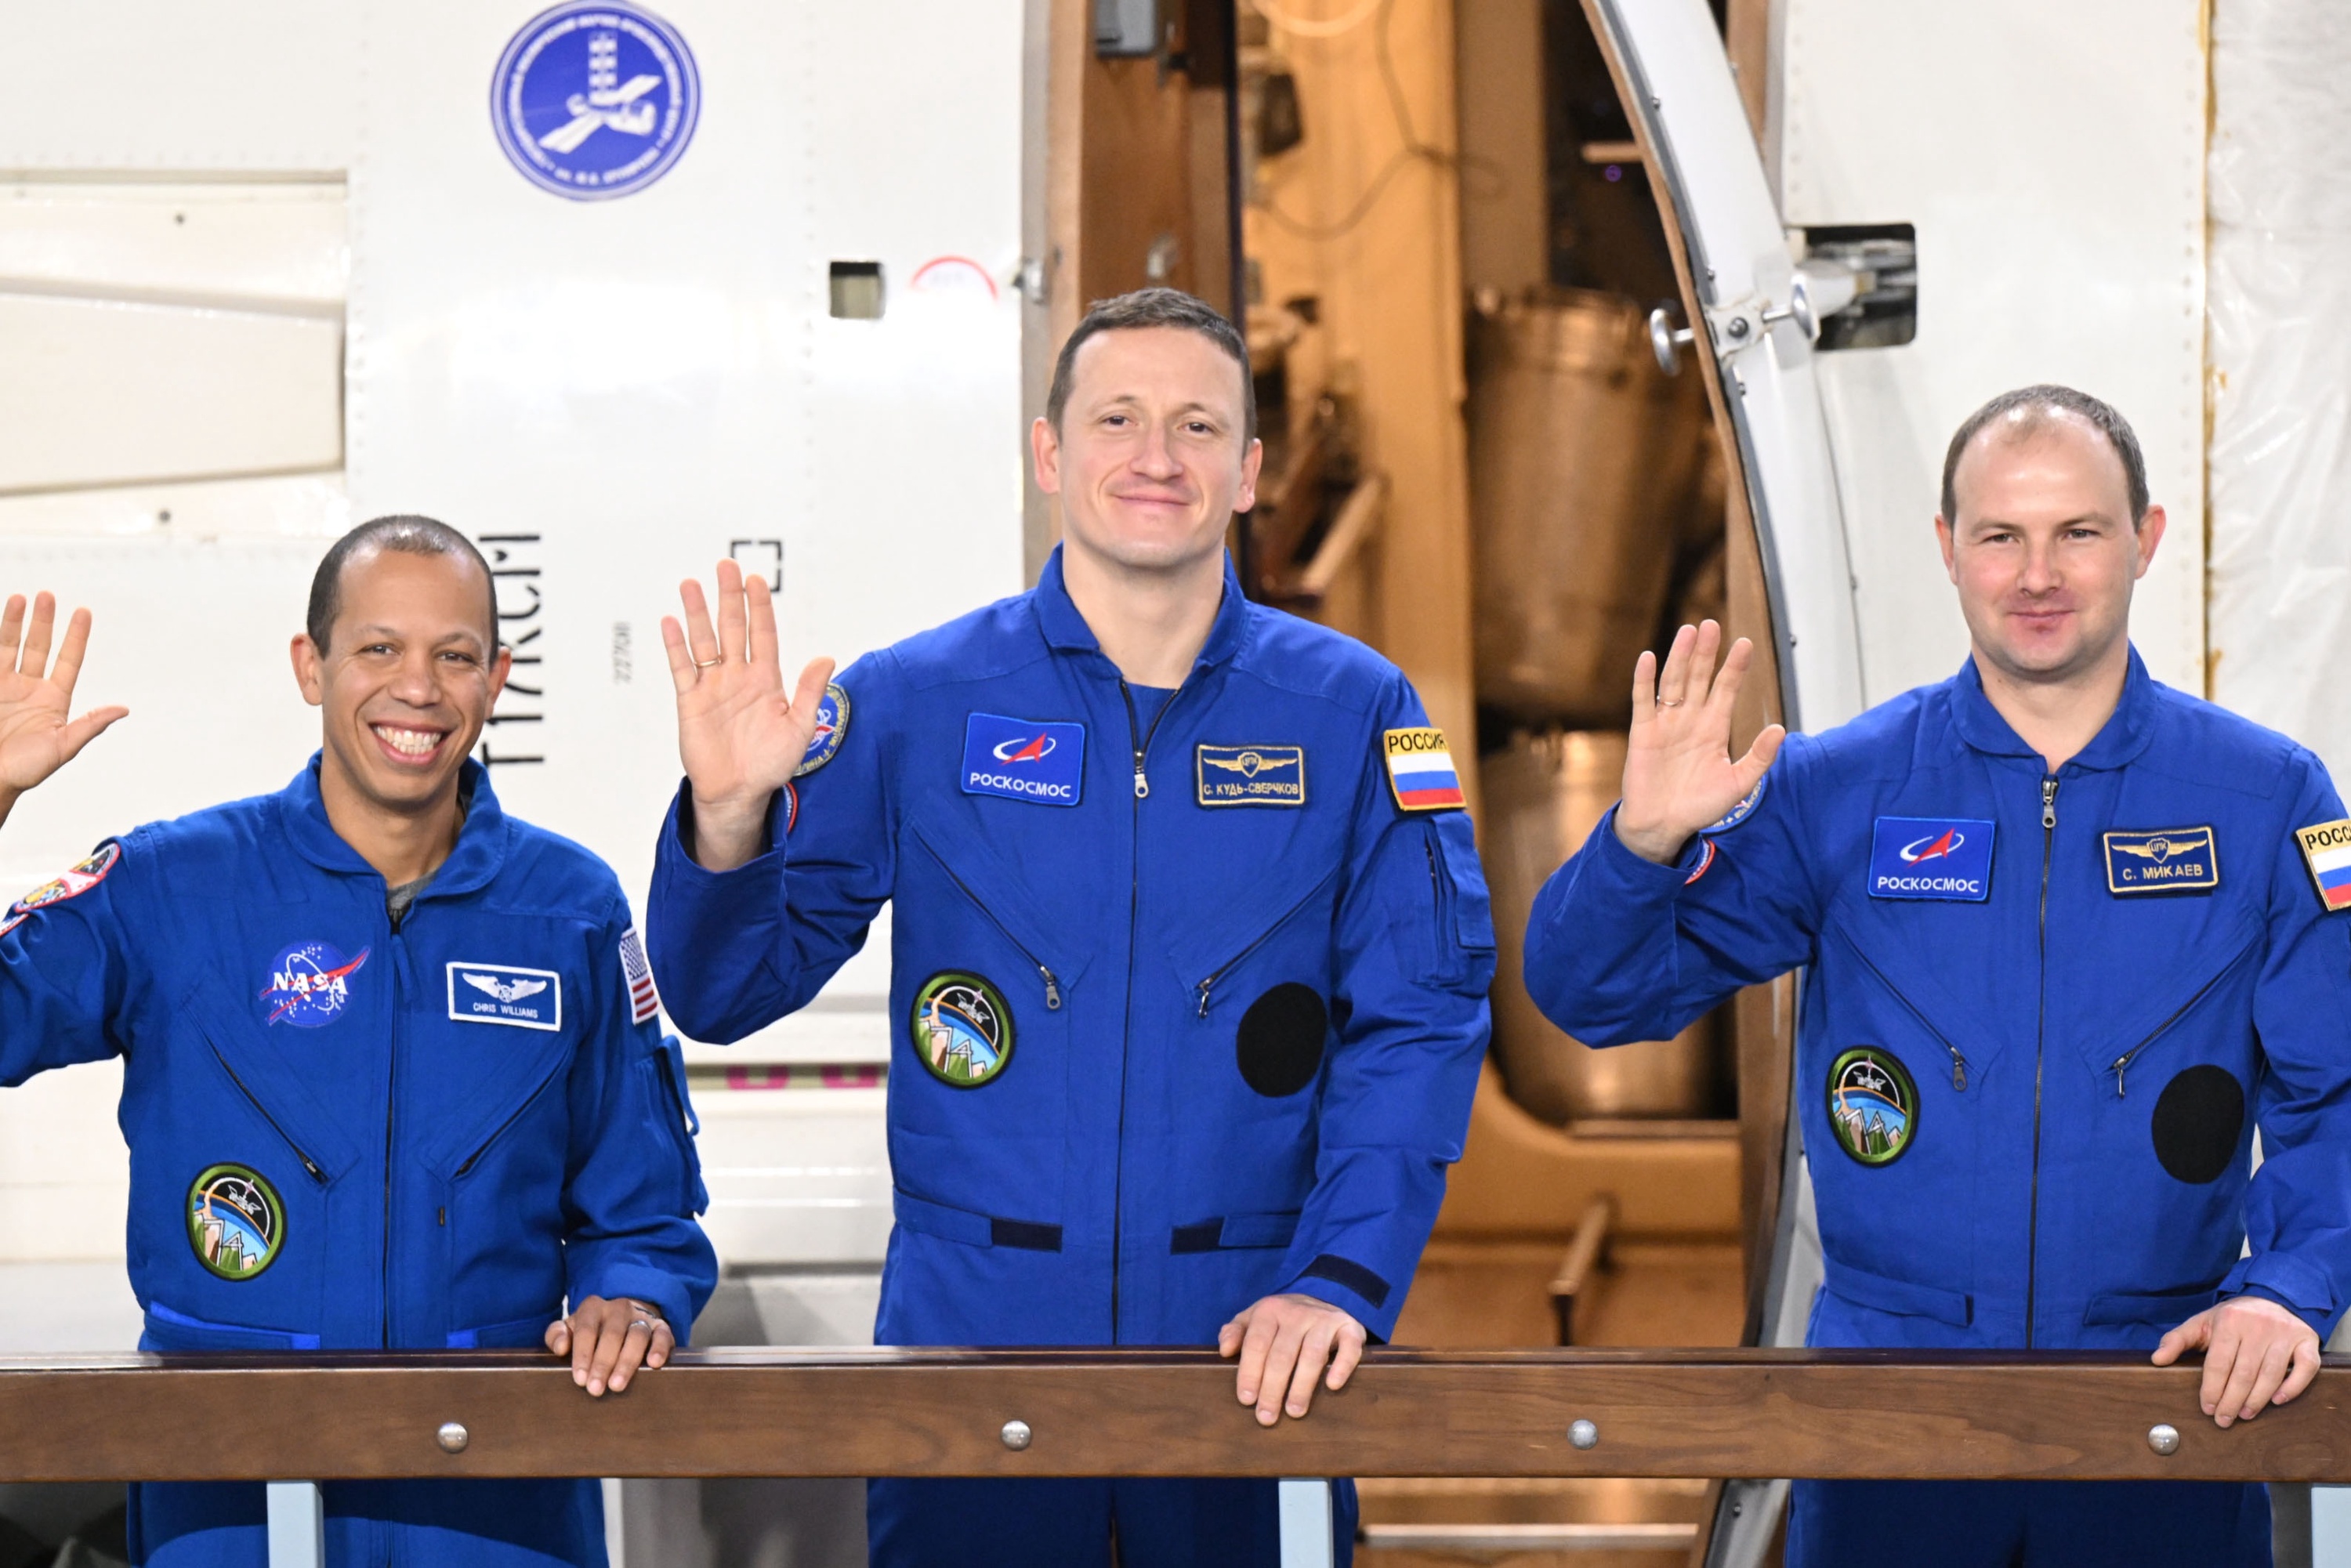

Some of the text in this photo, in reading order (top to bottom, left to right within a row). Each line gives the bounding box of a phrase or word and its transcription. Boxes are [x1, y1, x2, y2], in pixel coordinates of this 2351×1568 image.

[969, 772, 1071, 798] РОСКОСМОС
[1204, 782, 1299, 796] С. КУДЬ-СВЕРЧКОВ
[2305, 826, 2351, 849] РОСС
[2123, 864, 2203, 881] С. МИКАЕВ
[1877, 876, 1980, 893] РОСКОСМОС
[273, 972, 348, 994] NASA
[473, 1002, 538, 1019] CHRIS WILLIAMS
